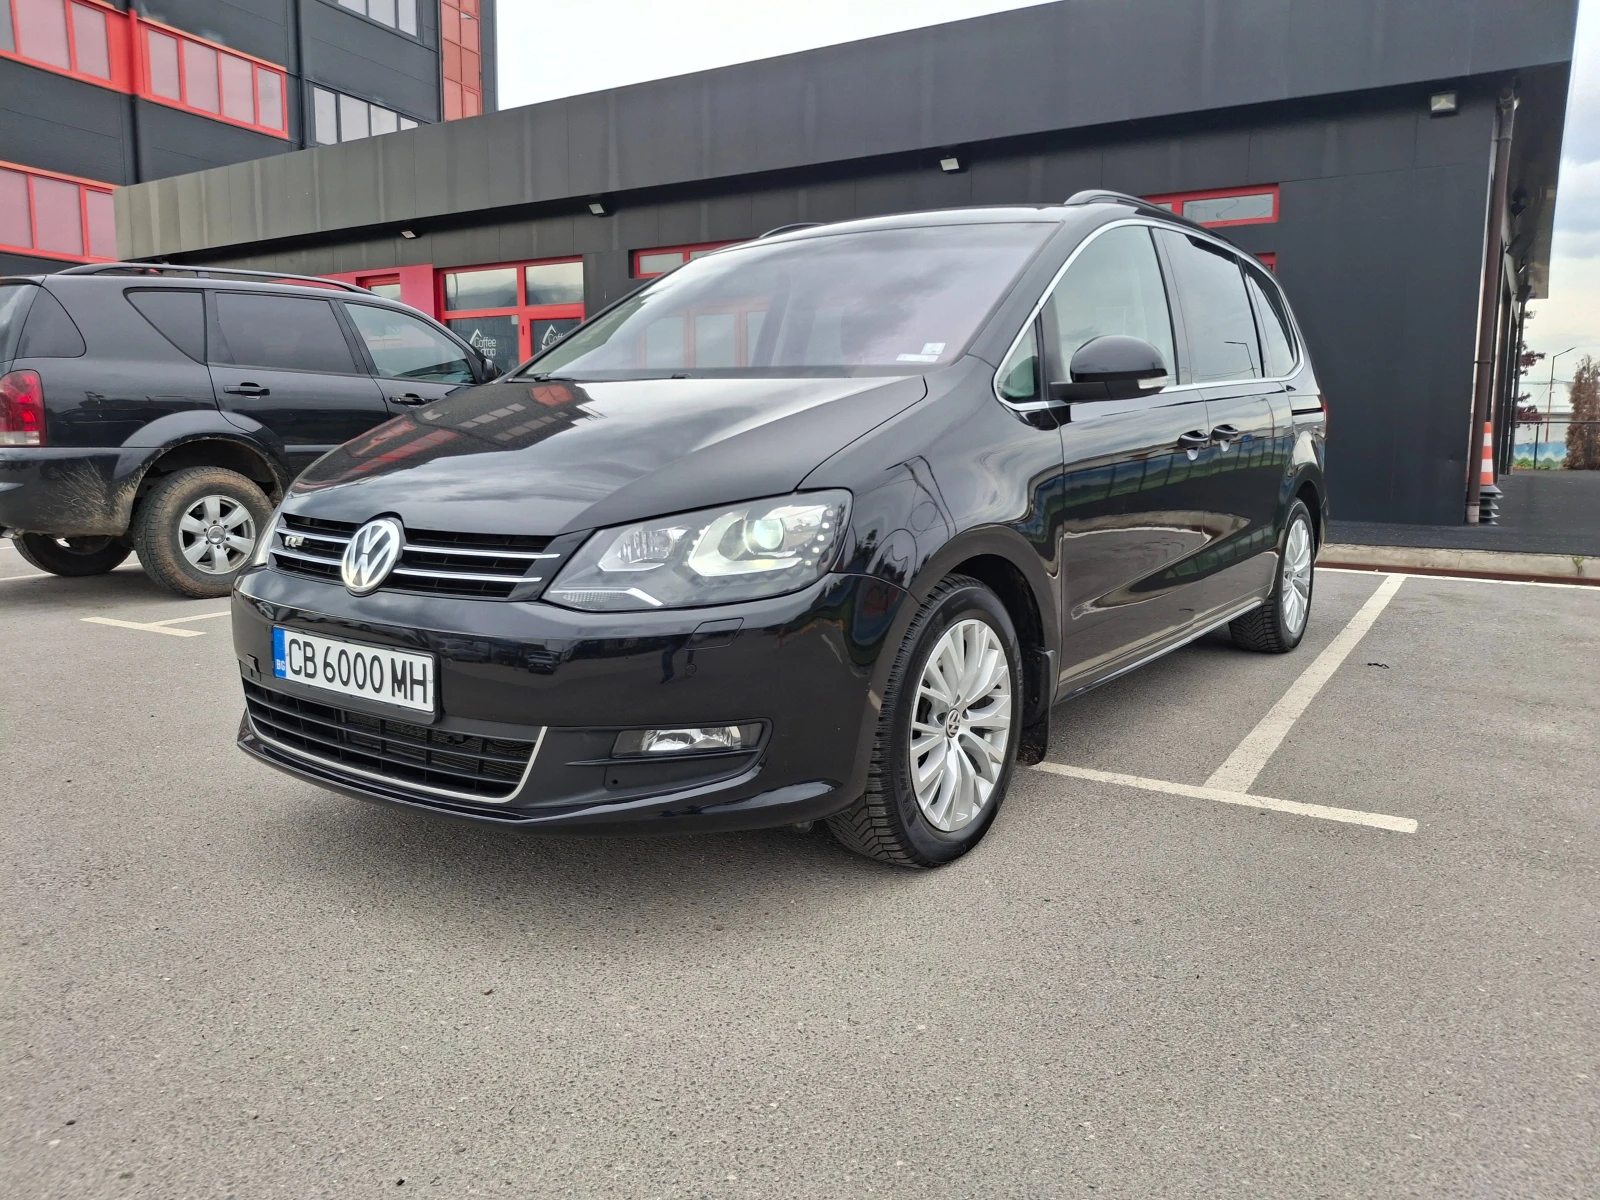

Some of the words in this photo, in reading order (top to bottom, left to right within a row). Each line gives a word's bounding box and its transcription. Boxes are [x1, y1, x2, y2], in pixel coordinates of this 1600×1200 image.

[475, 336, 497, 348] Coffee
[275, 659, 286, 672] BG
[288, 638, 318, 679] CB
[323, 645, 384, 694] 6000
[390, 657, 428, 704] MH
